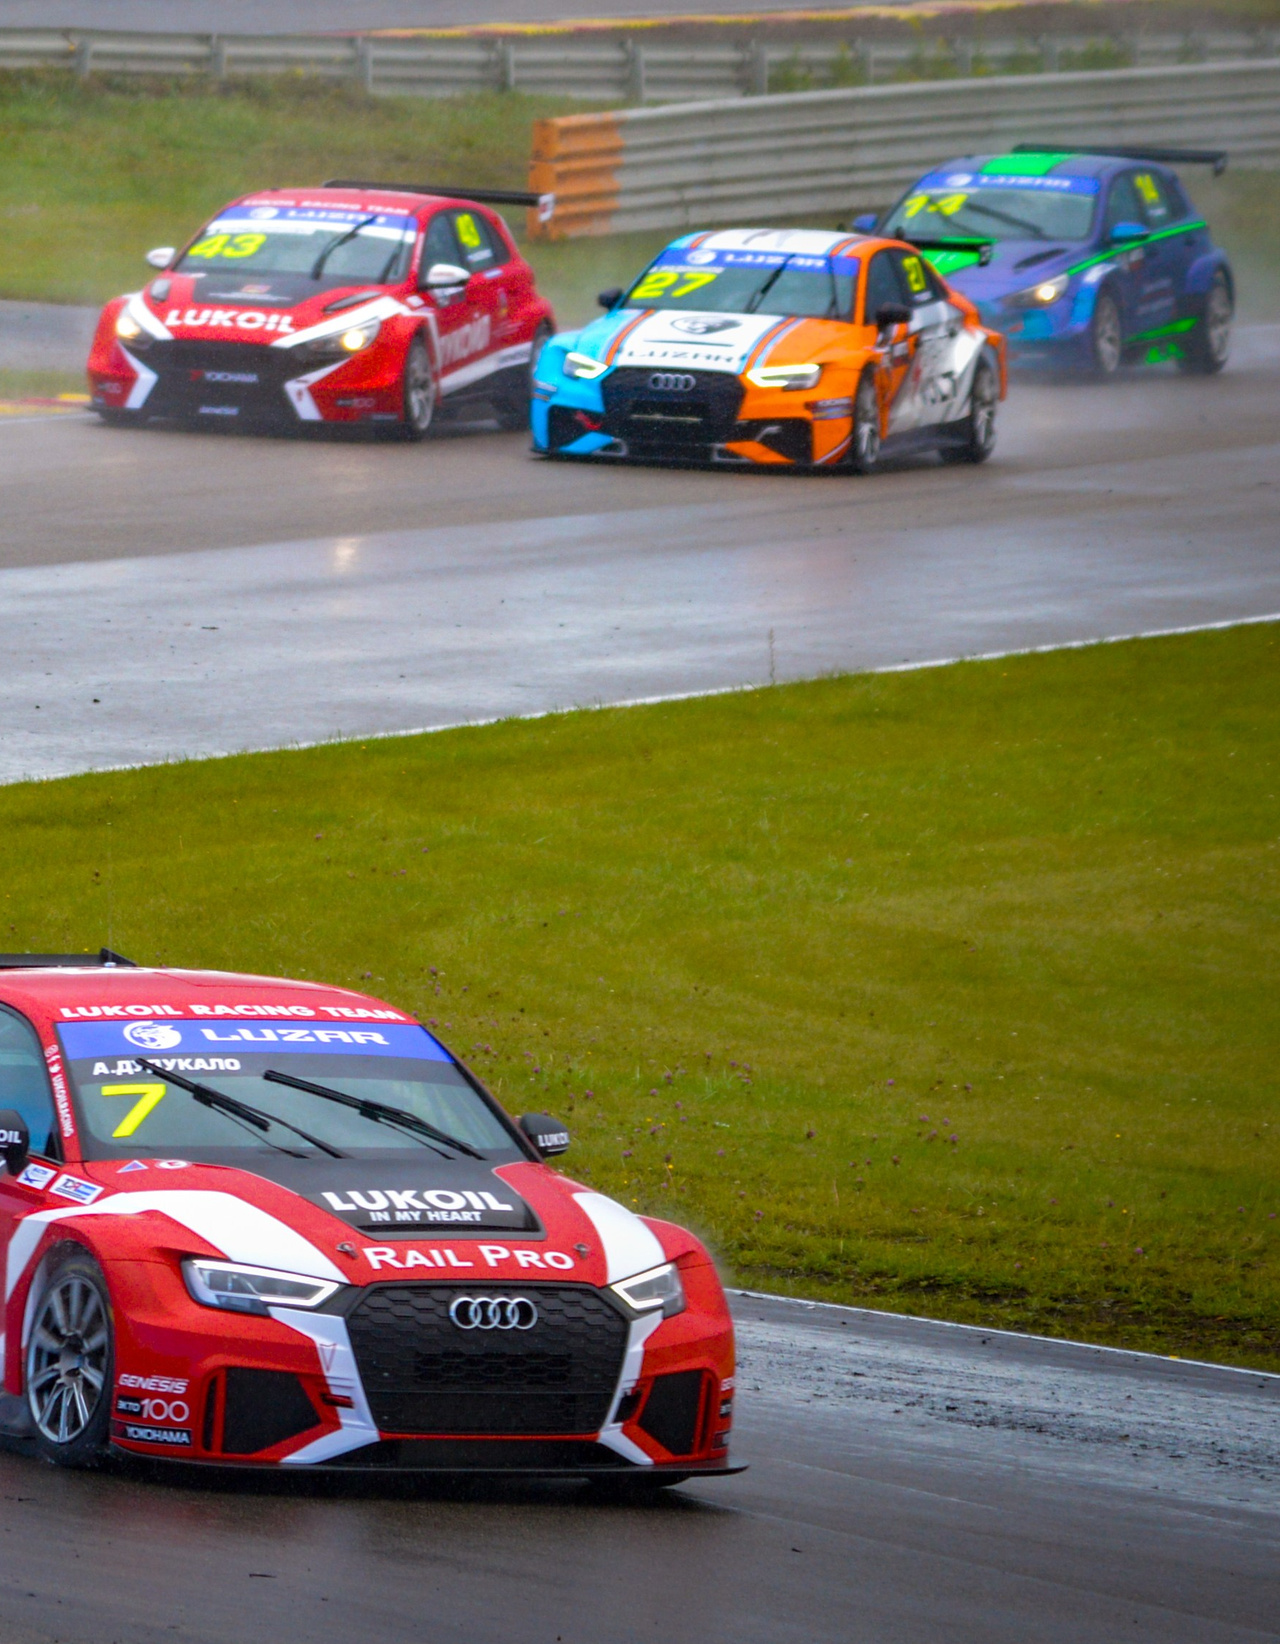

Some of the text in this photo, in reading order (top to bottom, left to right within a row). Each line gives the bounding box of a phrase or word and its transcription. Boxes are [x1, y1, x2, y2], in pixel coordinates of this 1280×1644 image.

[188, 234, 267, 258] 43
[724, 253, 827, 267] LUZAR
[631, 272, 717, 299] 27
[164, 309, 296, 333] LUKOIL
[627, 350, 734, 363] LUZAR
[59, 1004, 407, 1021] LUKOIL RACING TEAM
[200, 1028, 391, 1046] LUZAR
[101, 1083, 167, 1138] 7
[320, 1189, 514, 1211] LUKOIL
[369, 1211, 483, 1223] IN MY HEART
[361, 1244, 575, 1270] RAIL PRO
[118, 1373, 189, 1394] GENESIS
[141, 1398, 190, 1422] 100
[126, 1426, 191, 1443] YOKOHAMA
